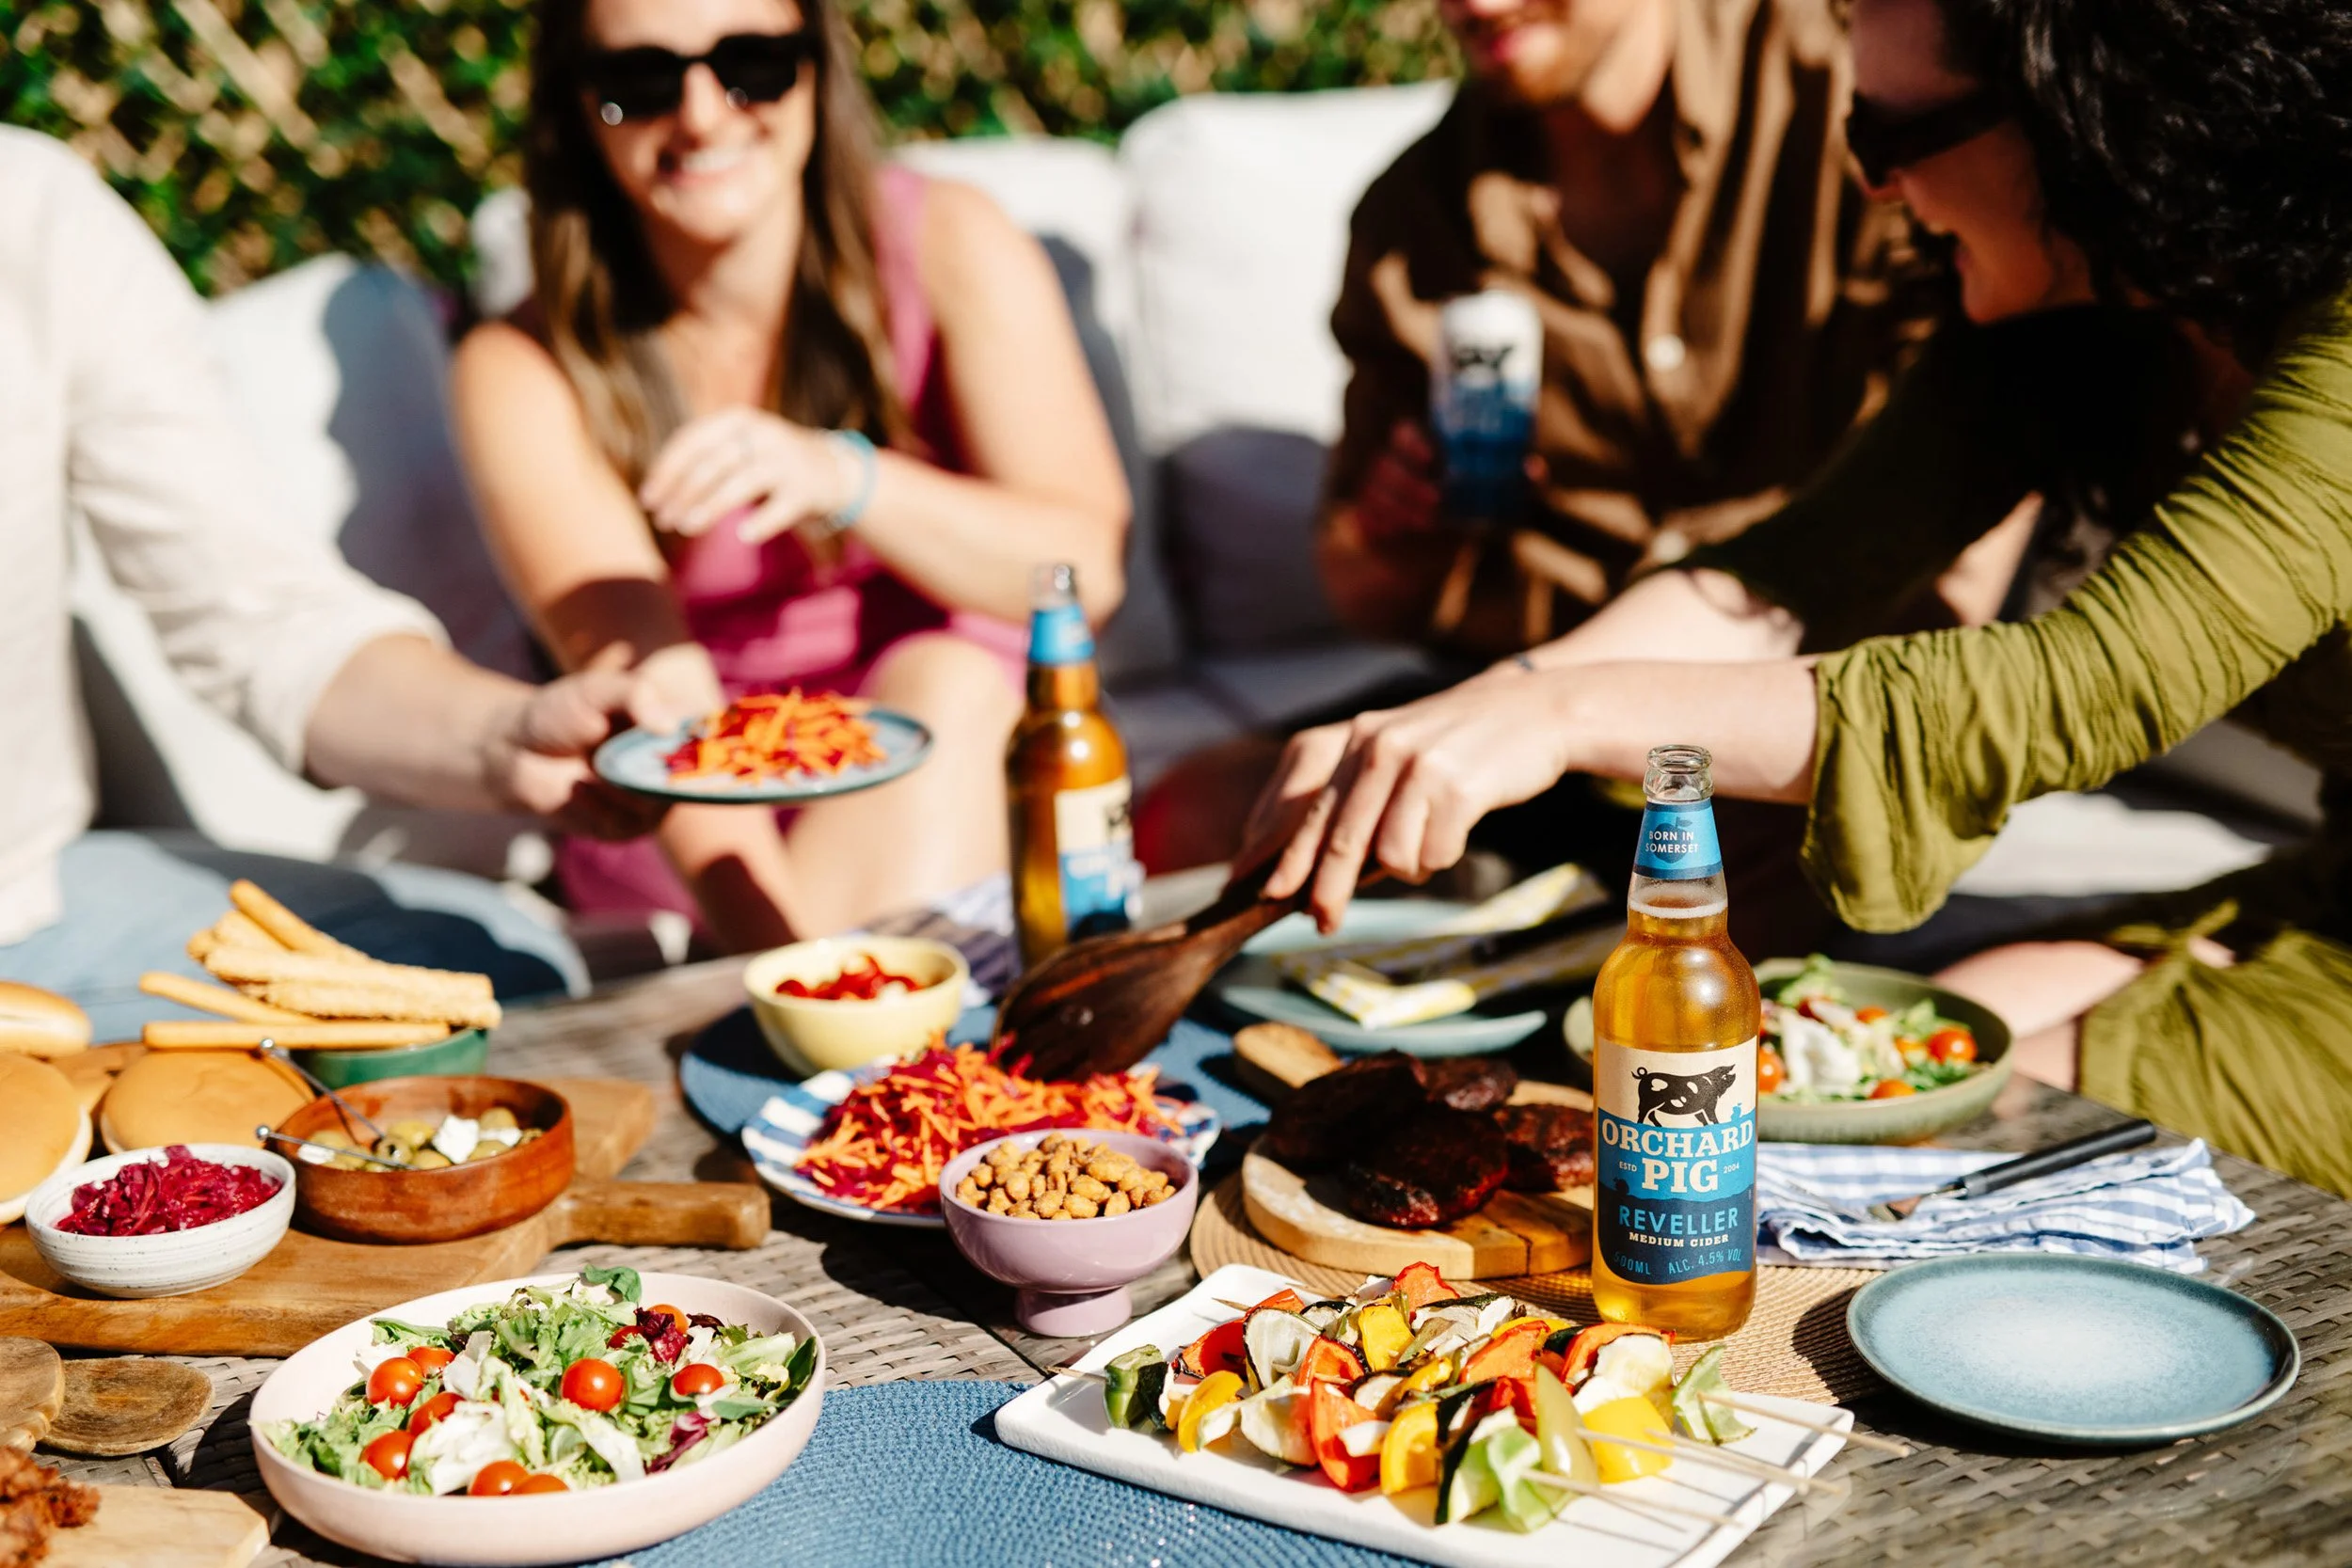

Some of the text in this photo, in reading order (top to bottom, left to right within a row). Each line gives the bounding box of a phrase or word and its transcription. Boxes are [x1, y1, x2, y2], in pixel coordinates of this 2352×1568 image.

[1648, 831, 1694, 841] BORN IN
[1645, 843, 1699, 853] SOMERSET
[1602, 1119, 1753, 1157] ORCHARD
[1618, 1161, 1740, 1174] ESTD 2004
[1642, 1158, 1719, 1193] PIG
[1618, 1204, 1739, 1235] REVELLER
[1629, 1231, 1729, 1247] MEDIUM CIDER
[1613, 1248, 1742, 1275] 500ML ALC. 4.5% VOL
